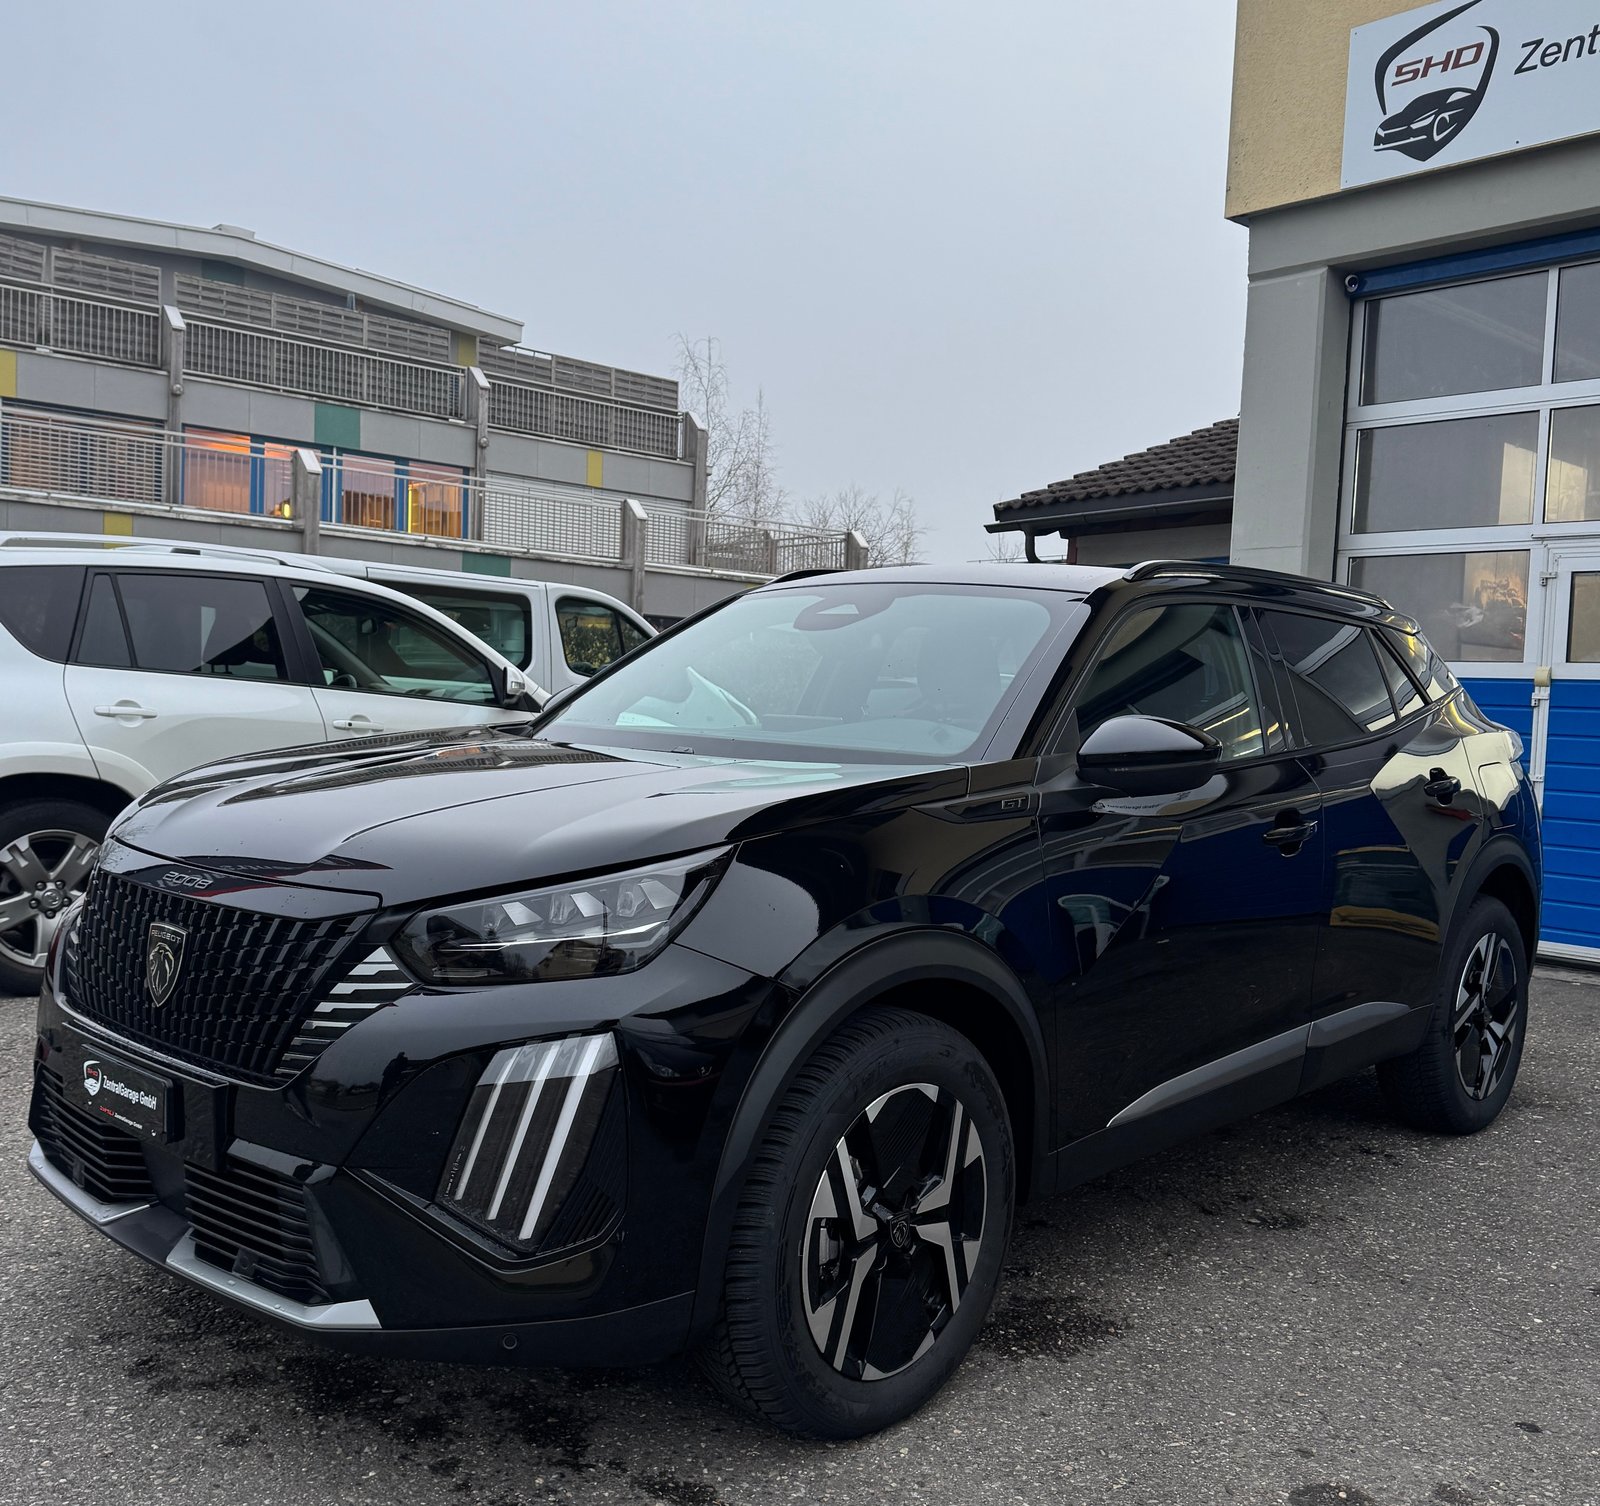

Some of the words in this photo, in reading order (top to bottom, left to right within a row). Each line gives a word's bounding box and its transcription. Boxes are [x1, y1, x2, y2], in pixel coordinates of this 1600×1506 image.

[1514, 24, 1600, 76] Zent
[1391, 41, 1485, 87] SHD
[1001, 796, 1027, 810] GT
[162, 871, 214, 889] 2008
[151, 929, 182, 944] PEUGEOT
[103, 1075, 139, 1104] ZentralGarage
[139, 1091, 157, 1110] GmbH
